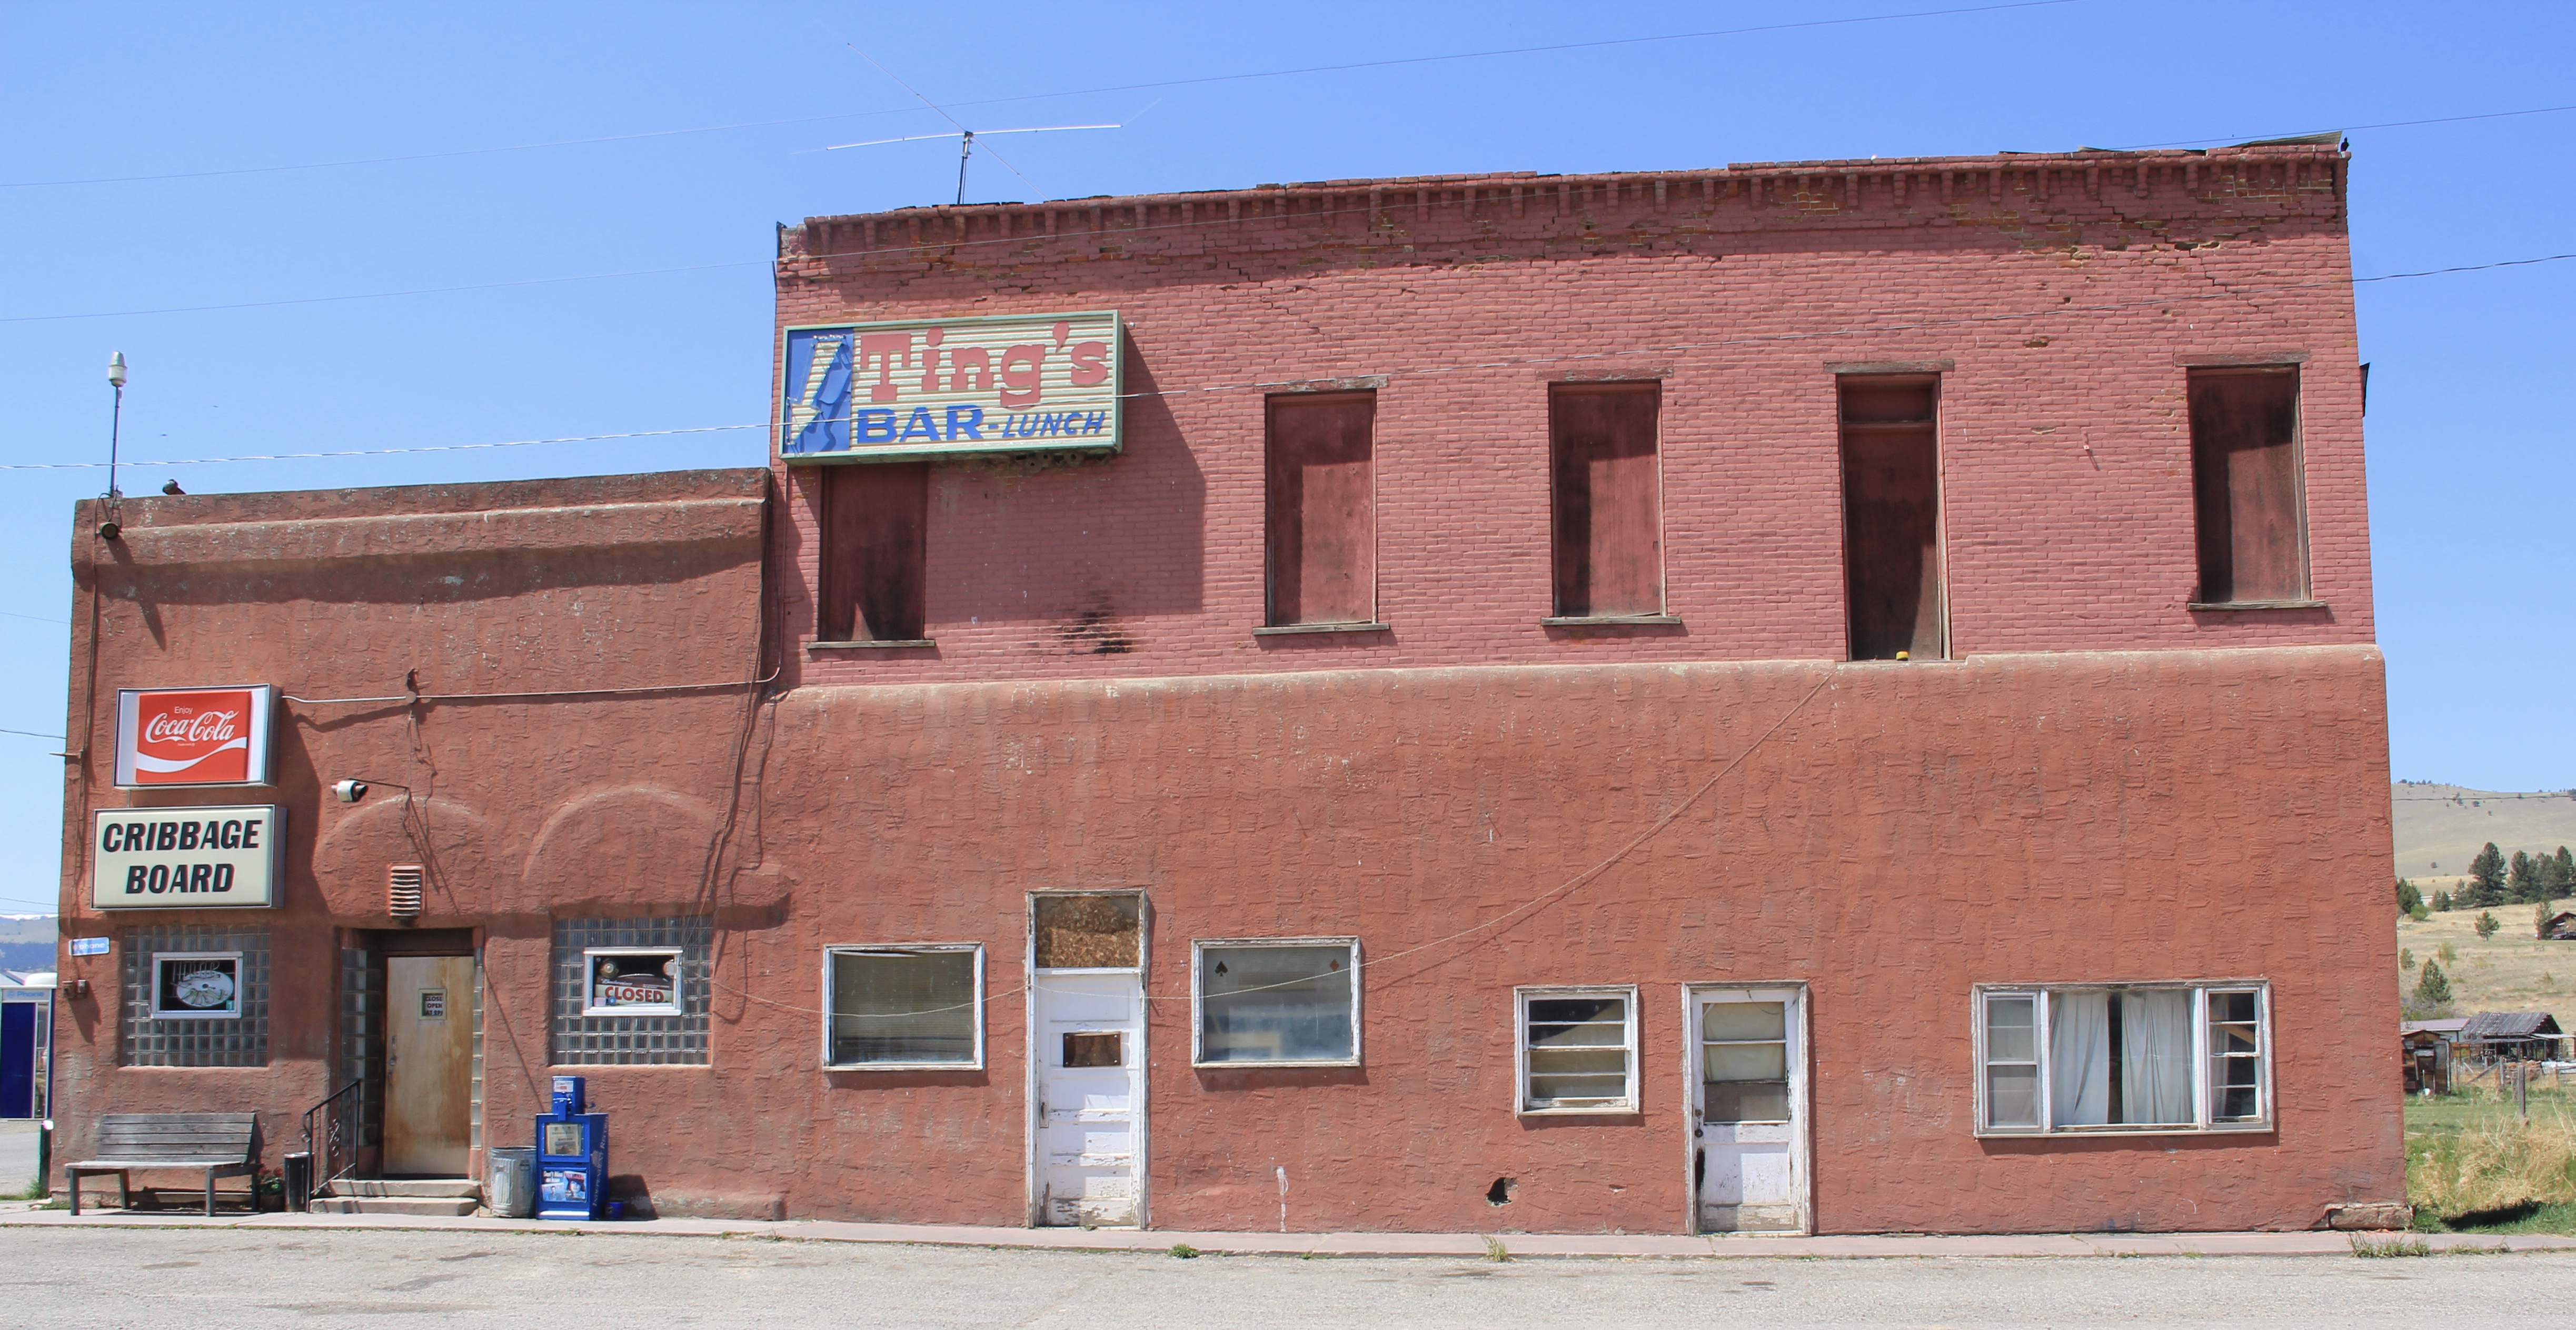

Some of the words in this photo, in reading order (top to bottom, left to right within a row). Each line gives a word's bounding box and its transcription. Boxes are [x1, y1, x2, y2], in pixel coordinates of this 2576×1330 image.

[860, 321, 1107, 409] Ting's
[145, 711, 239, 743] Coca-Cola
[103, 819, 263, 853] CRIBBAGE
[125, 863, 235, 894] BOARD
[605, 986, 664, 1003] CLOSED
